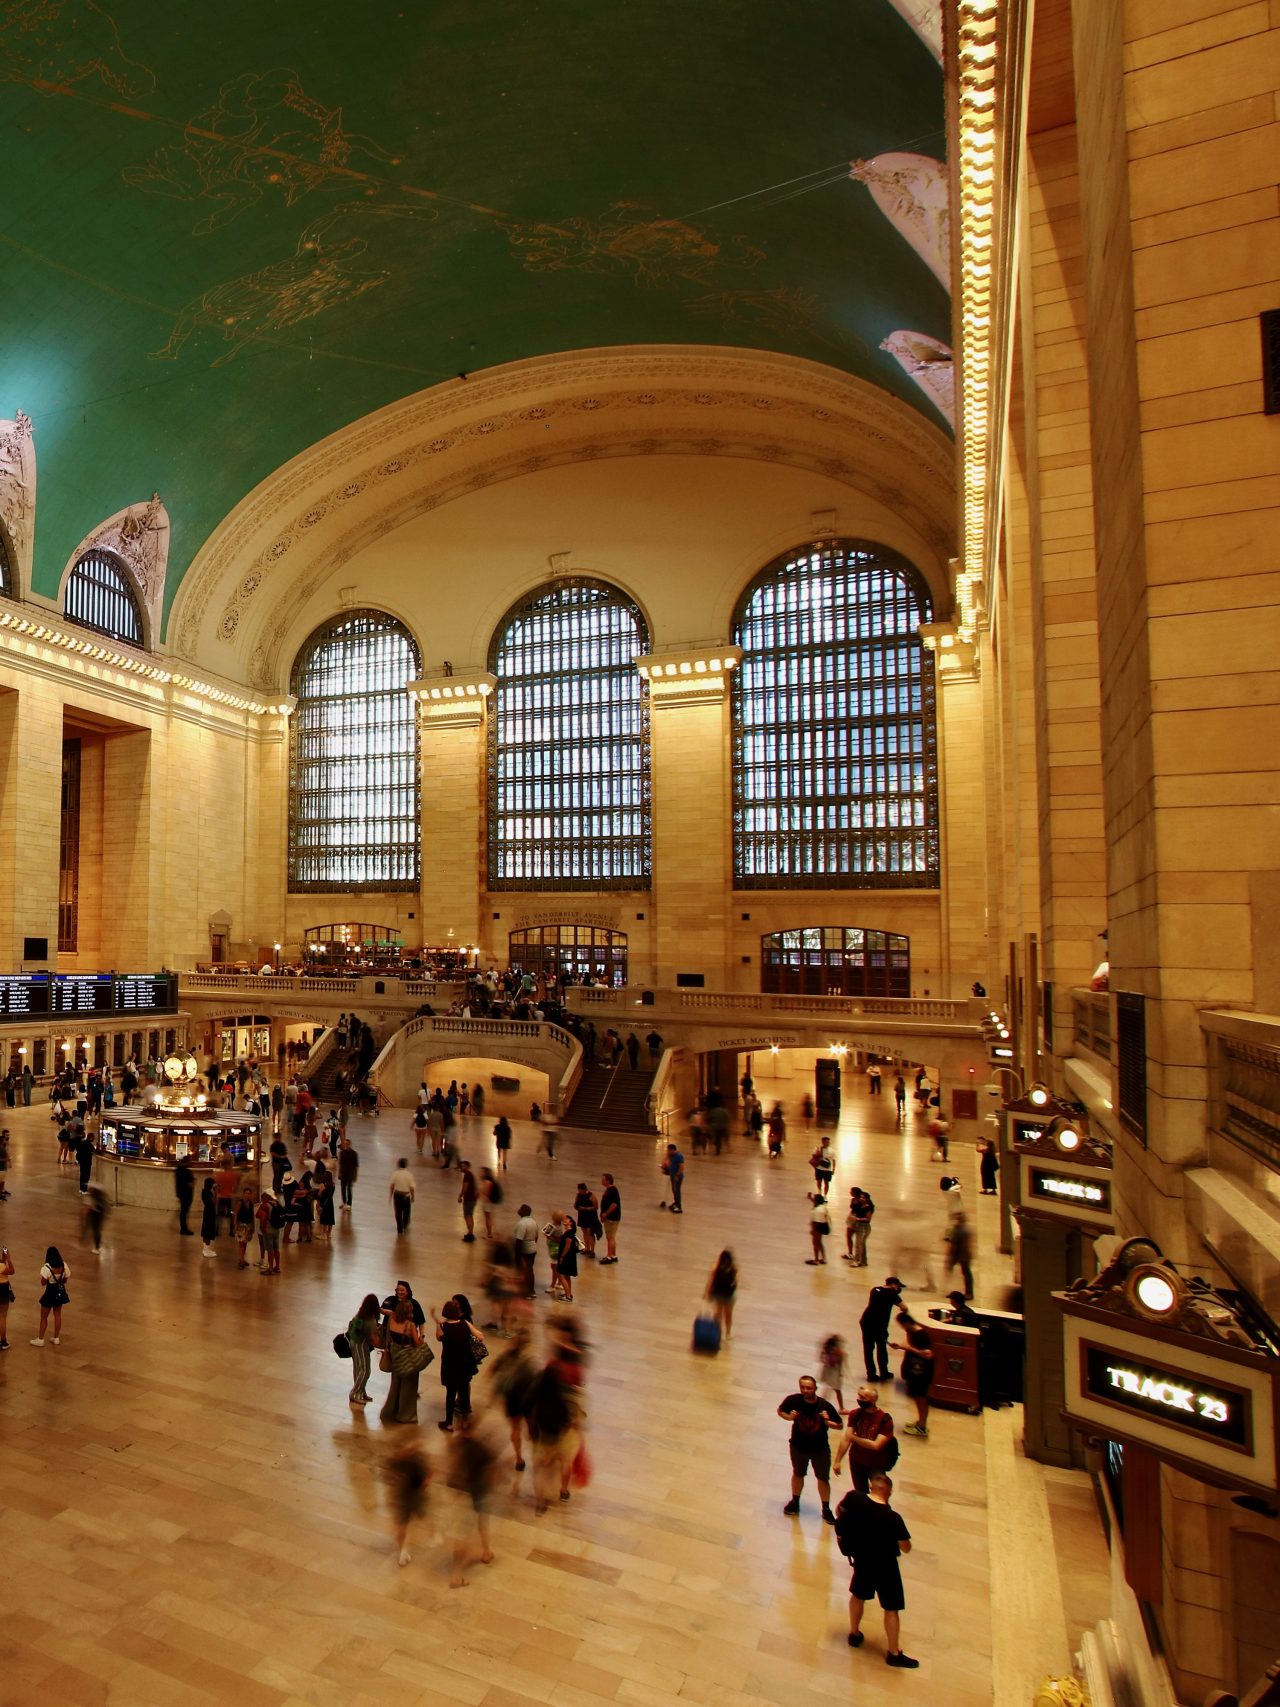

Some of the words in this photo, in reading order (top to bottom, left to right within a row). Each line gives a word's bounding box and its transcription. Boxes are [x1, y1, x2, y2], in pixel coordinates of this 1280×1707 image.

[534, 911, 579, 919] VANDERBILT
[575, 918, 620, 929] APARTMENT
[718, 1039, 746, 1048] TICKET
[750, 1036, 796, 1045] MACHINES
[828, 1038, 865, 1049] TCKS
[878, 1045, 891, 1054] TO
[1041, 1179, 1086, 1198] TRACK
[1106, 1366, 1195, 1413] TRACK
[1198, 1396, 1228, 1422] 23
